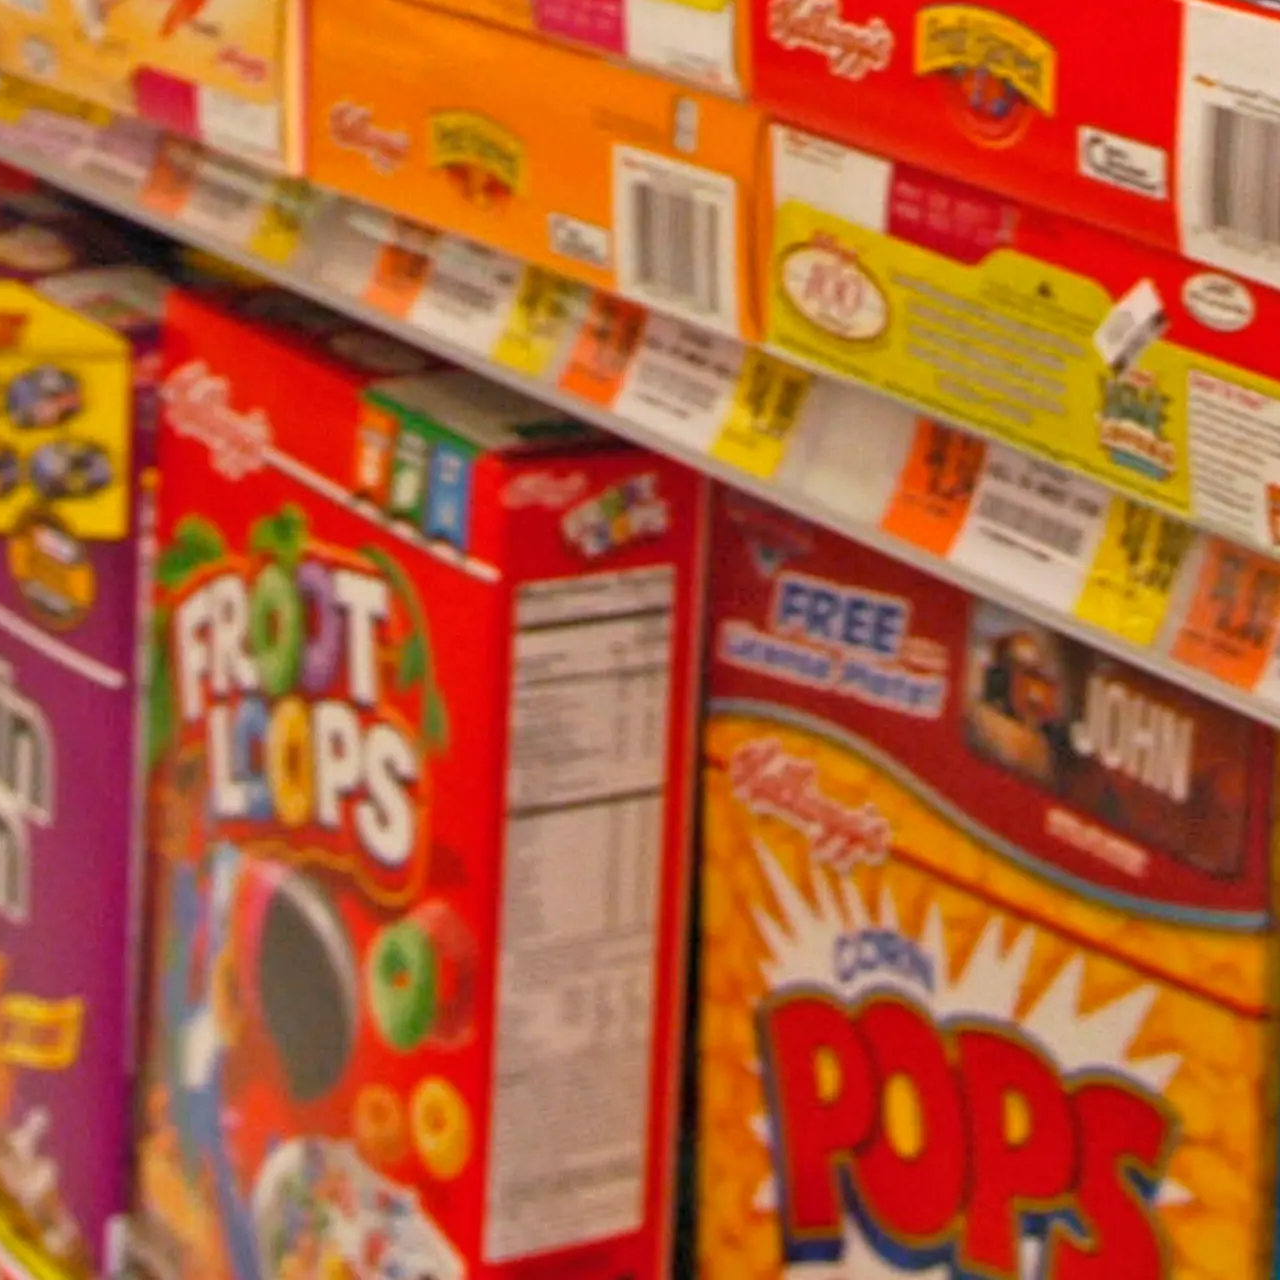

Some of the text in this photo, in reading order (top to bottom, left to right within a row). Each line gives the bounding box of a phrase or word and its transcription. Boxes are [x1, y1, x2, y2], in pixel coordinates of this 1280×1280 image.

[174, 557, 393, 724] FROOT
[780, 580, 905, 657] FREE
[208, 695, 418, 870] LOOPS
[1070, 672, 1195, 804] JOHN
[834, 930, 937, 994] CORN
[766, 991, 1172, 1280] POPS
